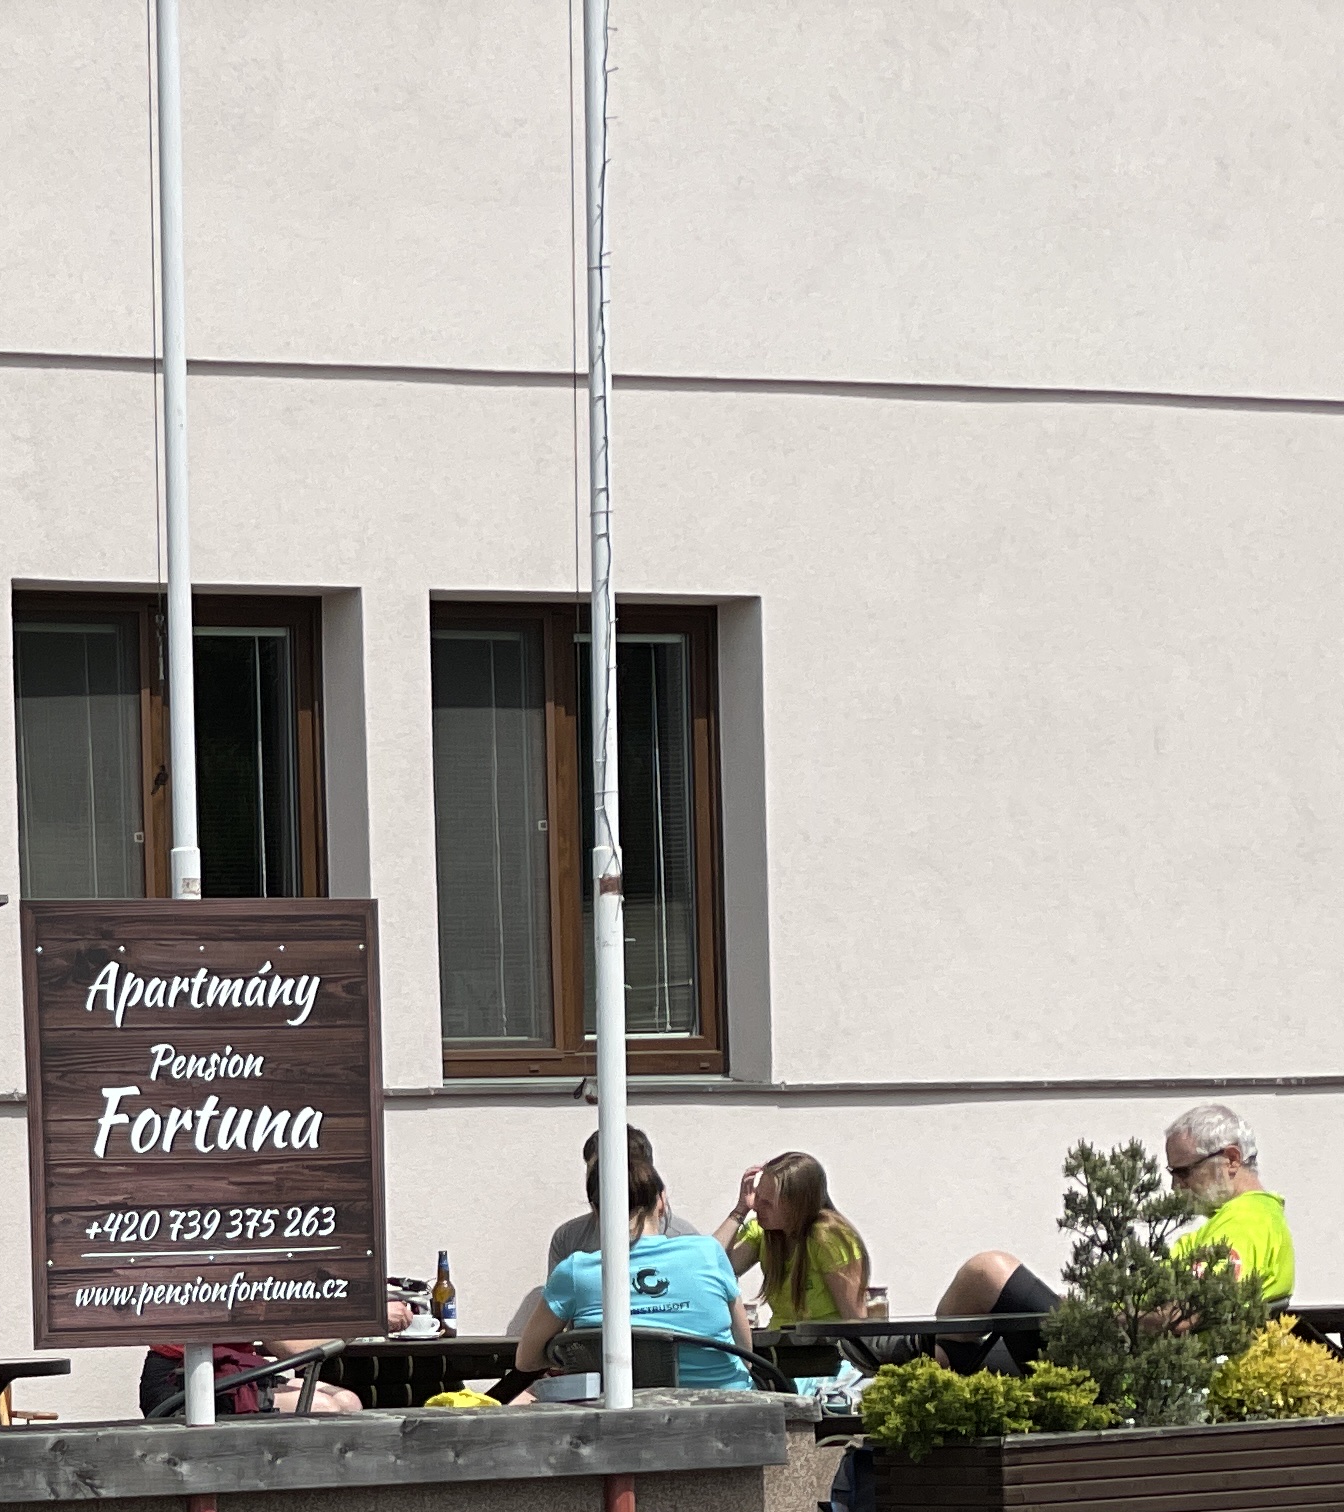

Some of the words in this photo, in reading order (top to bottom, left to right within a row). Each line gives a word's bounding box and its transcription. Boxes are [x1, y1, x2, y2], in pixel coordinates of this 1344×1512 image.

[85, 960, 321, 1028] Apartmány
[149, 1043, 265, 1082] Pension
[94, 1085, 324, 1159] Fortuna
[85, 1210, 161, 1243] +420
[168, 1208, 221, 1241] 739
[225, 1208, 279, 1239] 375
[283, 1206, 336, 1238] 263
[75, 1271, 348, 1316] www.pensionfortuna.cz
